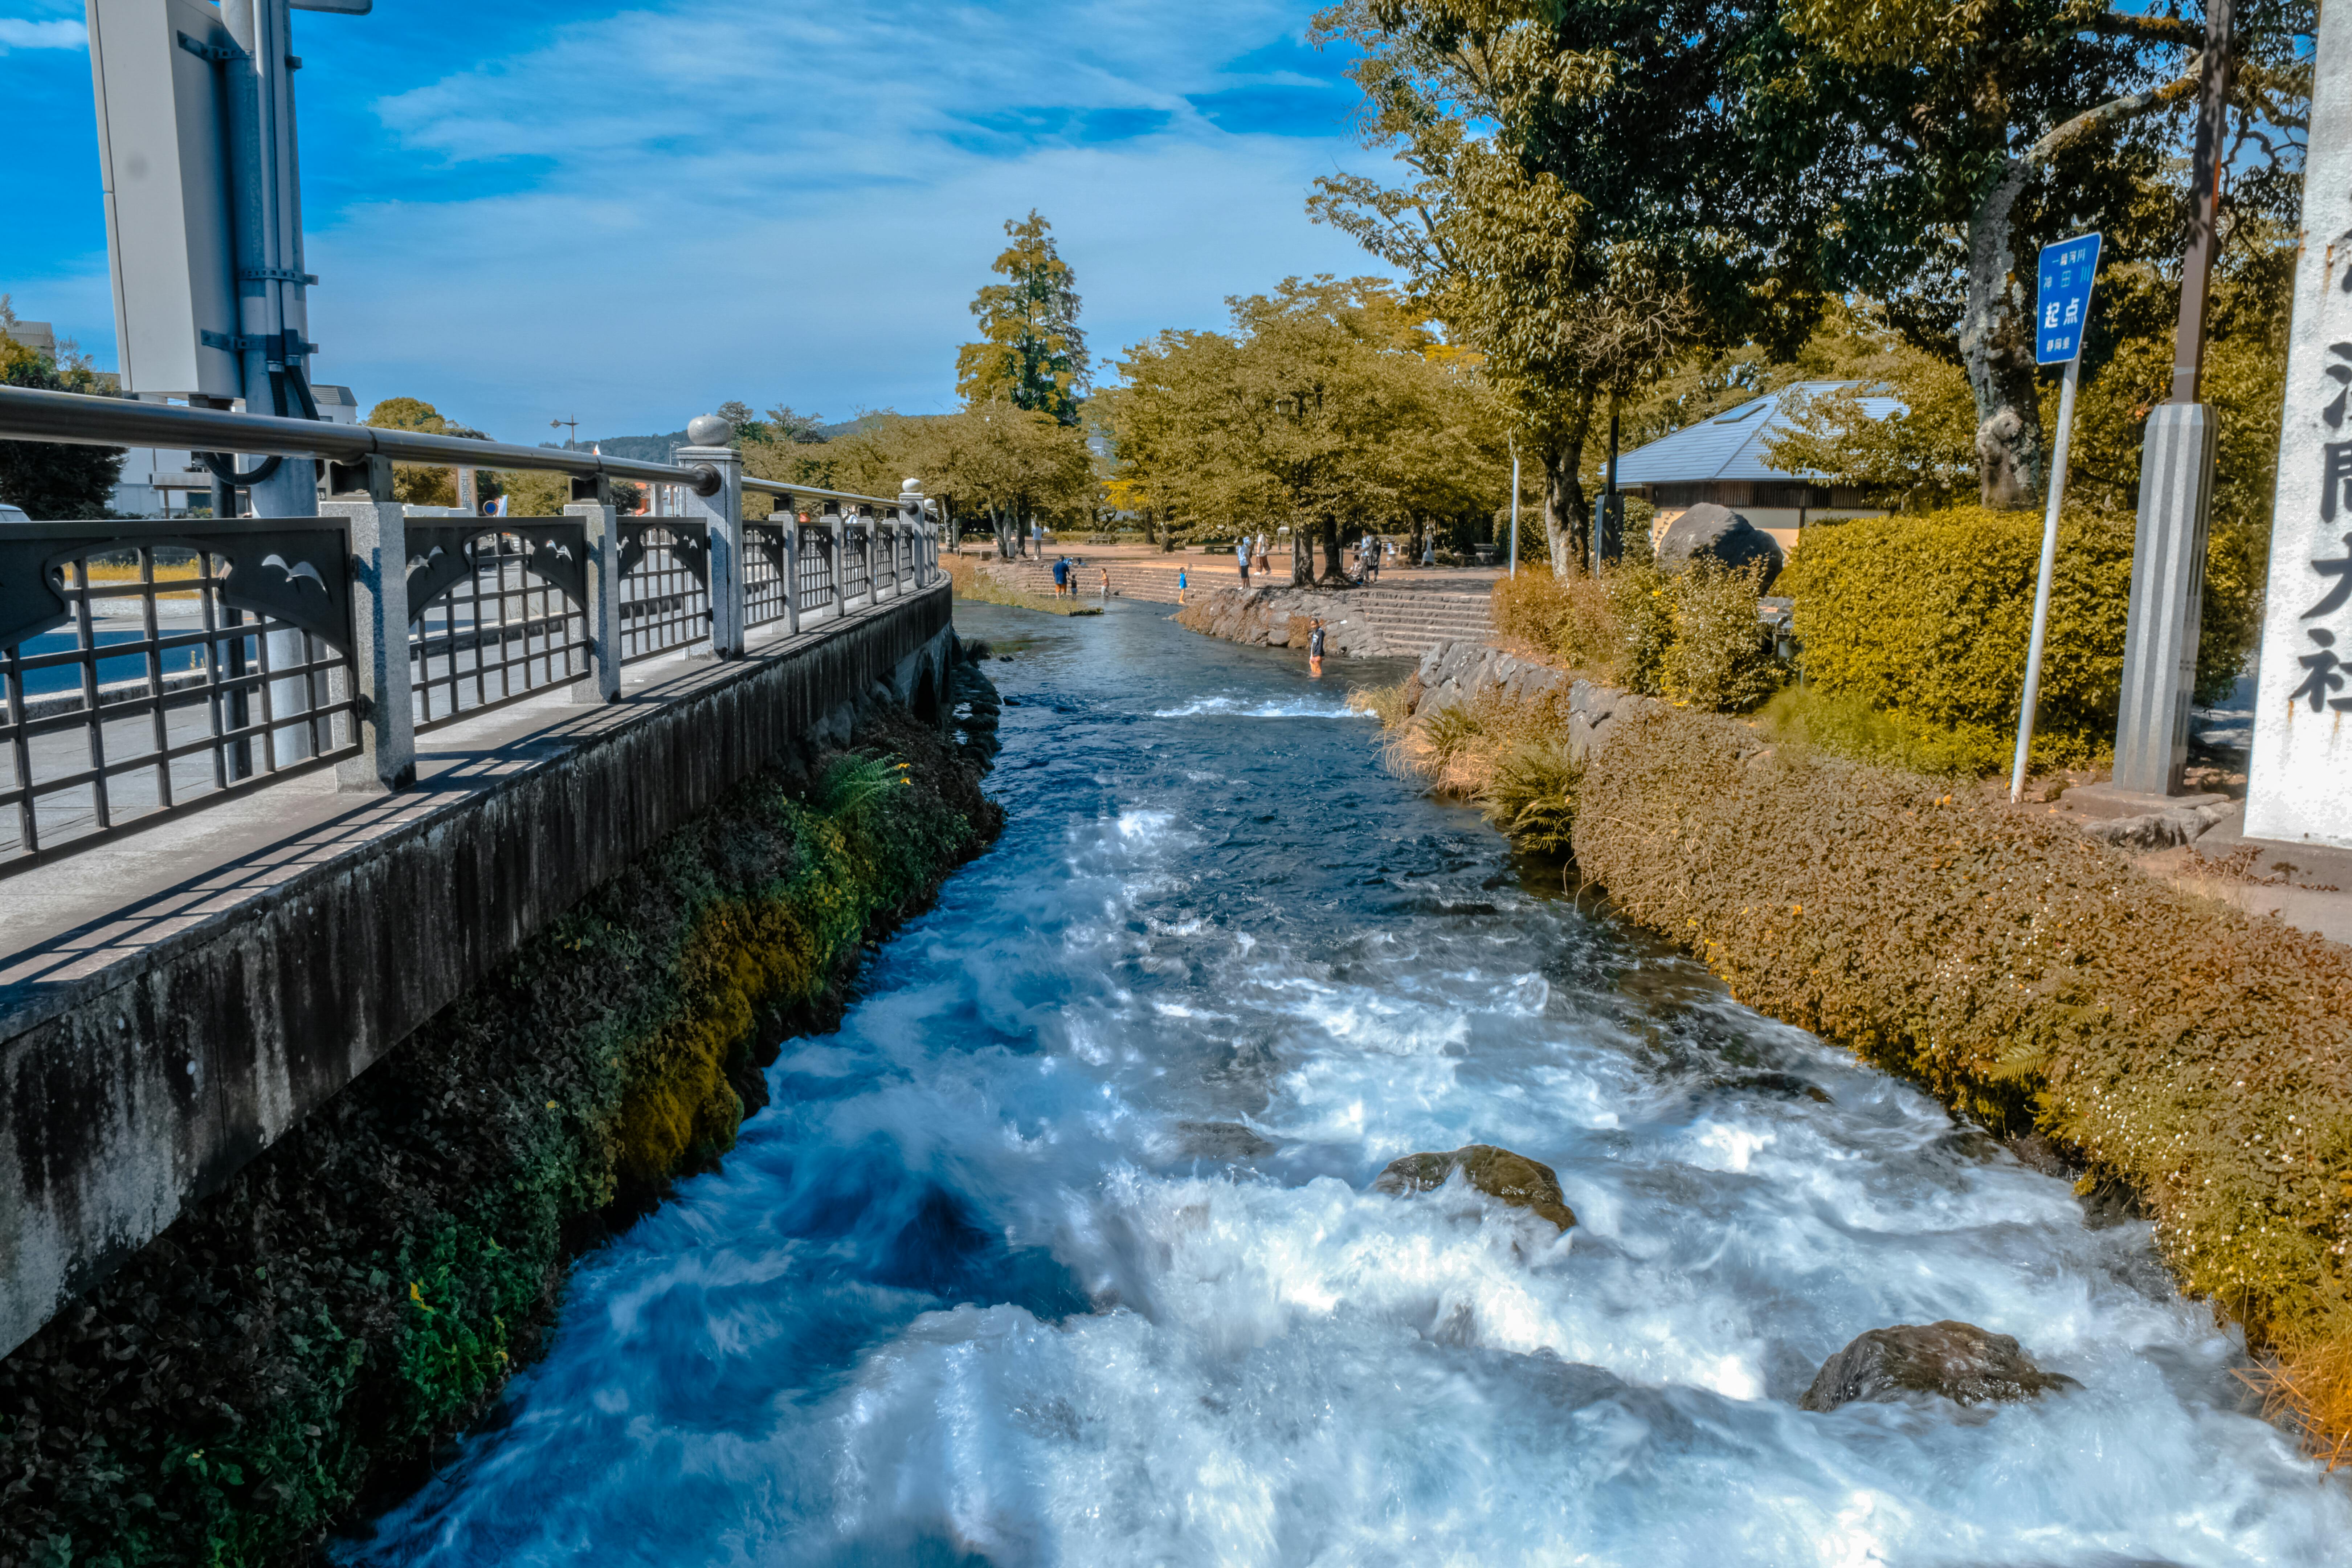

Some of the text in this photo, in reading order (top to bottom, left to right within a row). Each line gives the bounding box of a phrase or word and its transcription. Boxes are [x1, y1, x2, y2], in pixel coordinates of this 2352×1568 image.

[2043, 265, 2090, 291] 神田川
[2044, 297, 2079, 328] 起点
